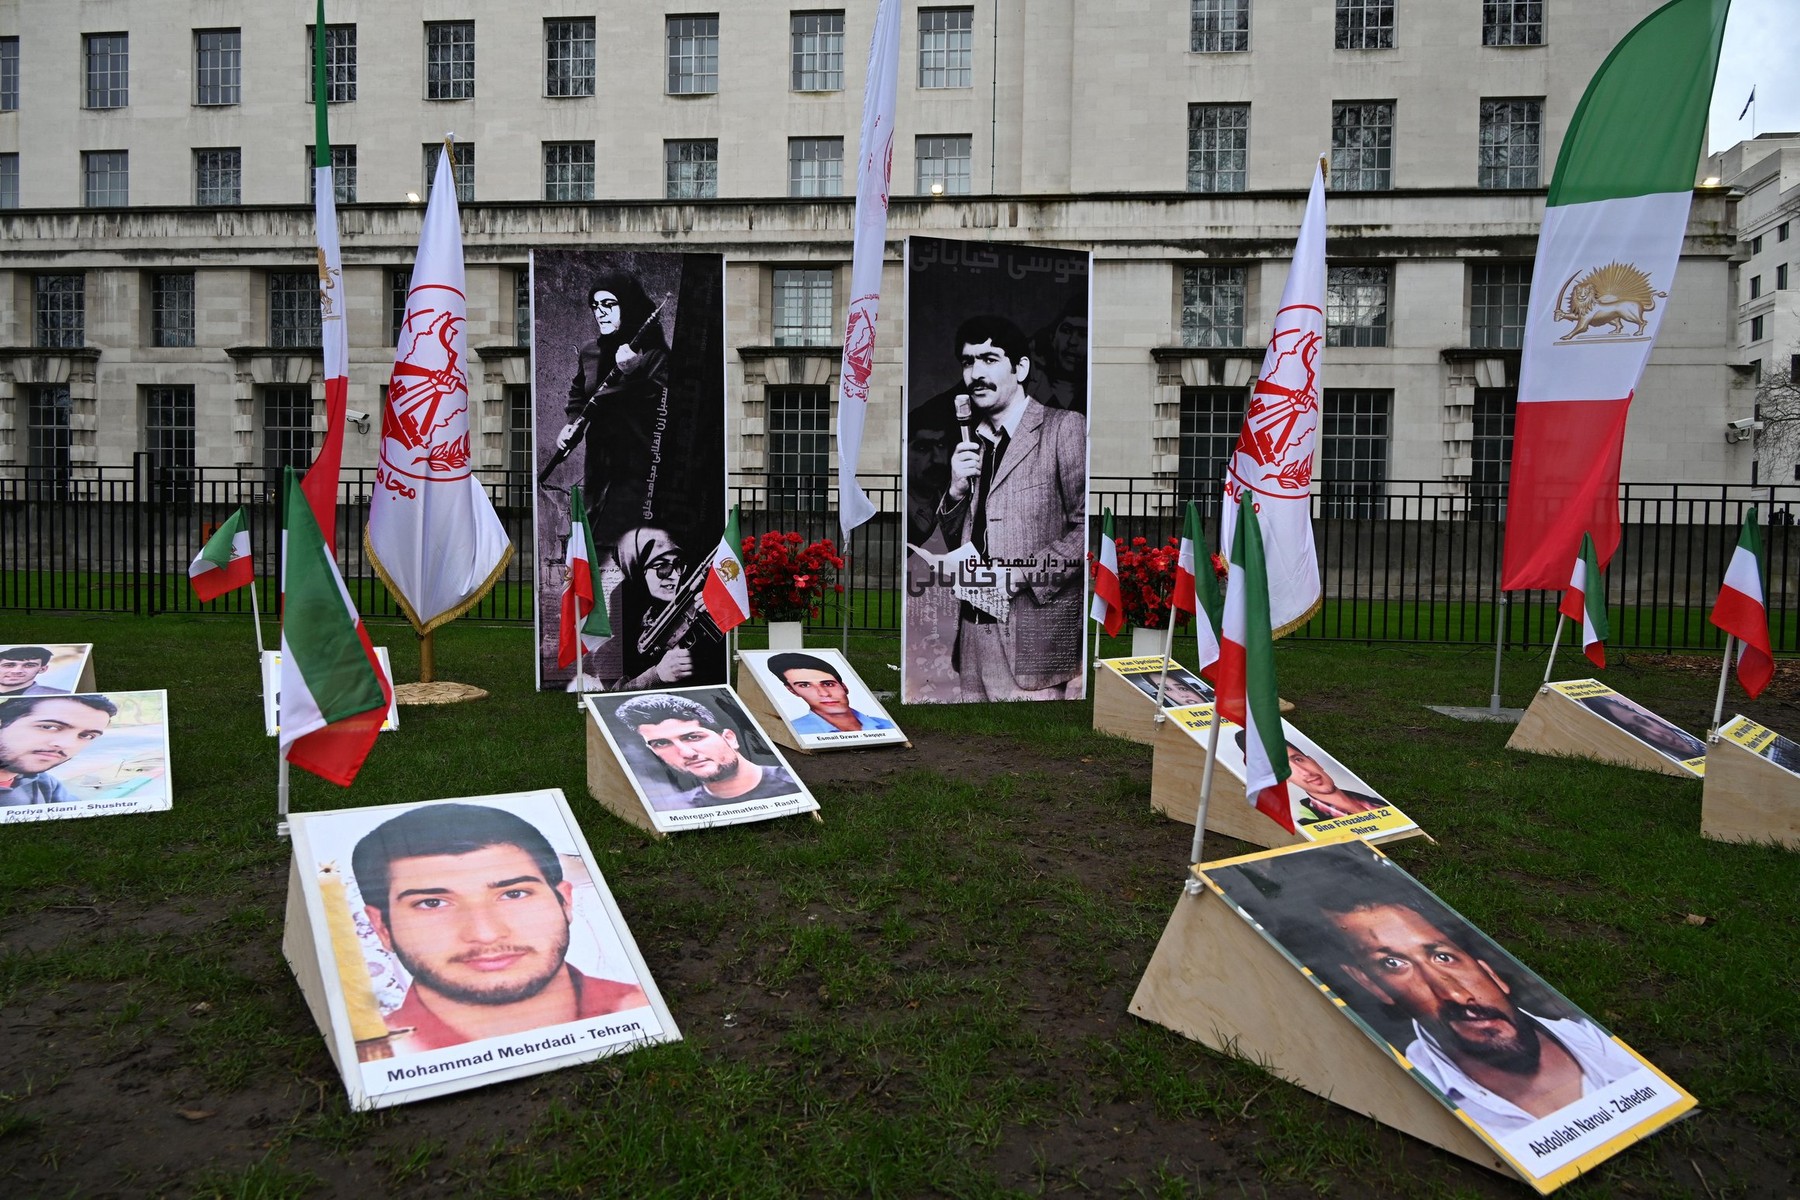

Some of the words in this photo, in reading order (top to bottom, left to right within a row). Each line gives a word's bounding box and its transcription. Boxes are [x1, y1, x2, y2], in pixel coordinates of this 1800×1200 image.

[377, 466, 416, 501] مجاه
[997, 553, 1037, 572] شهید
[1186, 718, 1212, 728] Falle
[1189, 709, 1212, 718] Iran
[6, 807, 43, 817] Poriya
[47, 804, 77, 813] Kiani
[87, 800, 139, 810] Shushtar
[669, 810, 715, 822] Mehregan
[715, 803, 769, 817] Zahmatkesh
[774, 798, 800, 808] Rasht
[1313, 822, 1336, 832] Sina
[1378, 809, 1392, 818] 22
[1350, 824, 1380, 835] Shiraz
[387, 1049, 494, 1083] Mohammad
[498, 1034, 577, 1059] Mehrdadi
[587, 1019, 641, 1041] Tehran
[1528, 1124, 1582, 1159] Abdollah
[1573, 1106, 1614, 1134] Naroui
[1610, 1085, 1658, 1114] Zahedan
